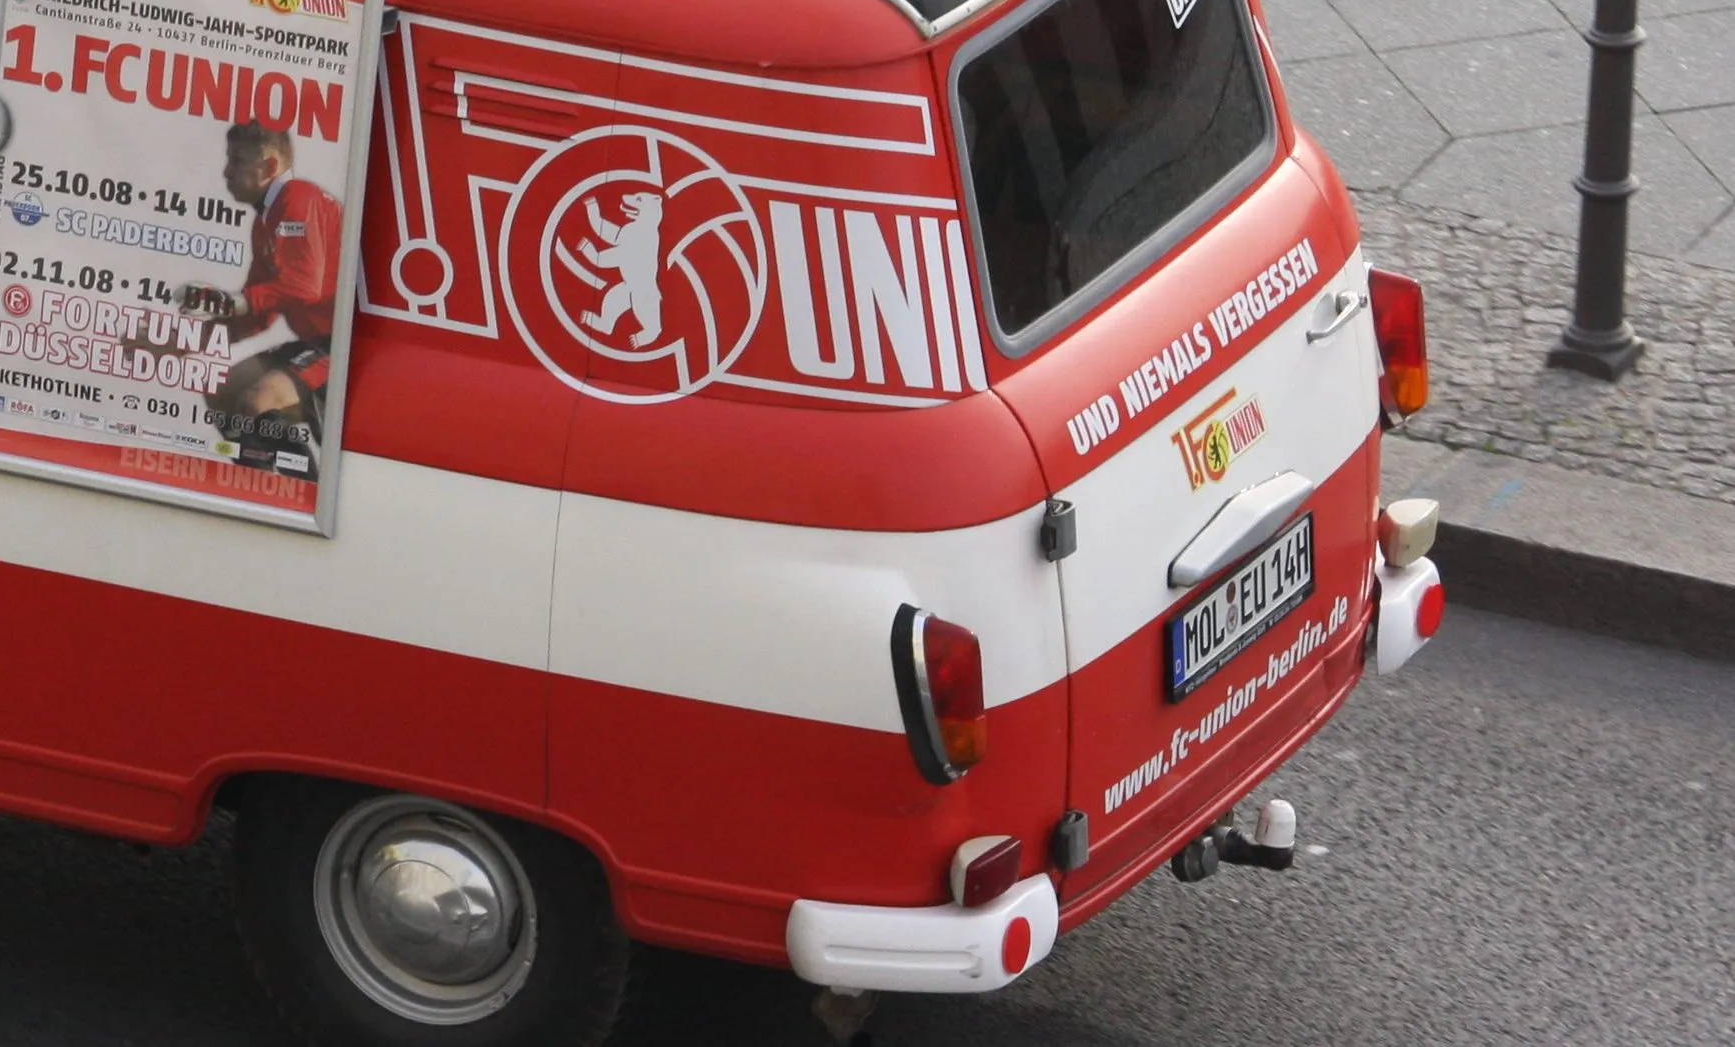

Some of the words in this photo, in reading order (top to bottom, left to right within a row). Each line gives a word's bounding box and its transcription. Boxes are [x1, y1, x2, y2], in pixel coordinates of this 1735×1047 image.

[35, 3, 122, 31] Cantianstraße
[128, 20, 142, 34] 24
[156, 28, 196, 44] 10437
[201, 35, 313, 67] Berlin-Prenzlauer
[317, 56, 346, 75] Berg
[145, 48, 344, 143] UNION
[11, 161, 132, 206] 25.10.08
[154, 190, 187, 216] 14
[197, 196, 246, 227] Uhr
[56, 206, 87, 236] SC
[91, 213, 244, 267] PADERBORN
[41, 289, 231, 360] FORTUNA
[137, 277, 172, 305] 14
[1066, 394, 1121, 456] UND
[1118, 322, 1212, 419] NIEMALS
[1207, 238, 1319, 348] VERGESSEN
[147, 398, 179, 418] 030
[203, 410, 226, 428] 65
[231, 414, 255, 433] 66
[288, 426, 310, 444] 93
[1225, 398, 1265, 455] UNION
[120, 446, 206, 482] EISERN
[216, 463, 309, 501] UNION!
[1185, 599, 1225, 670] MOL
[1240, 559, 1266, 626] EU
[1271, 525, 1309, 600] 14H
[1104, 596, 1348, 815] www.fc-union-berlin.de
